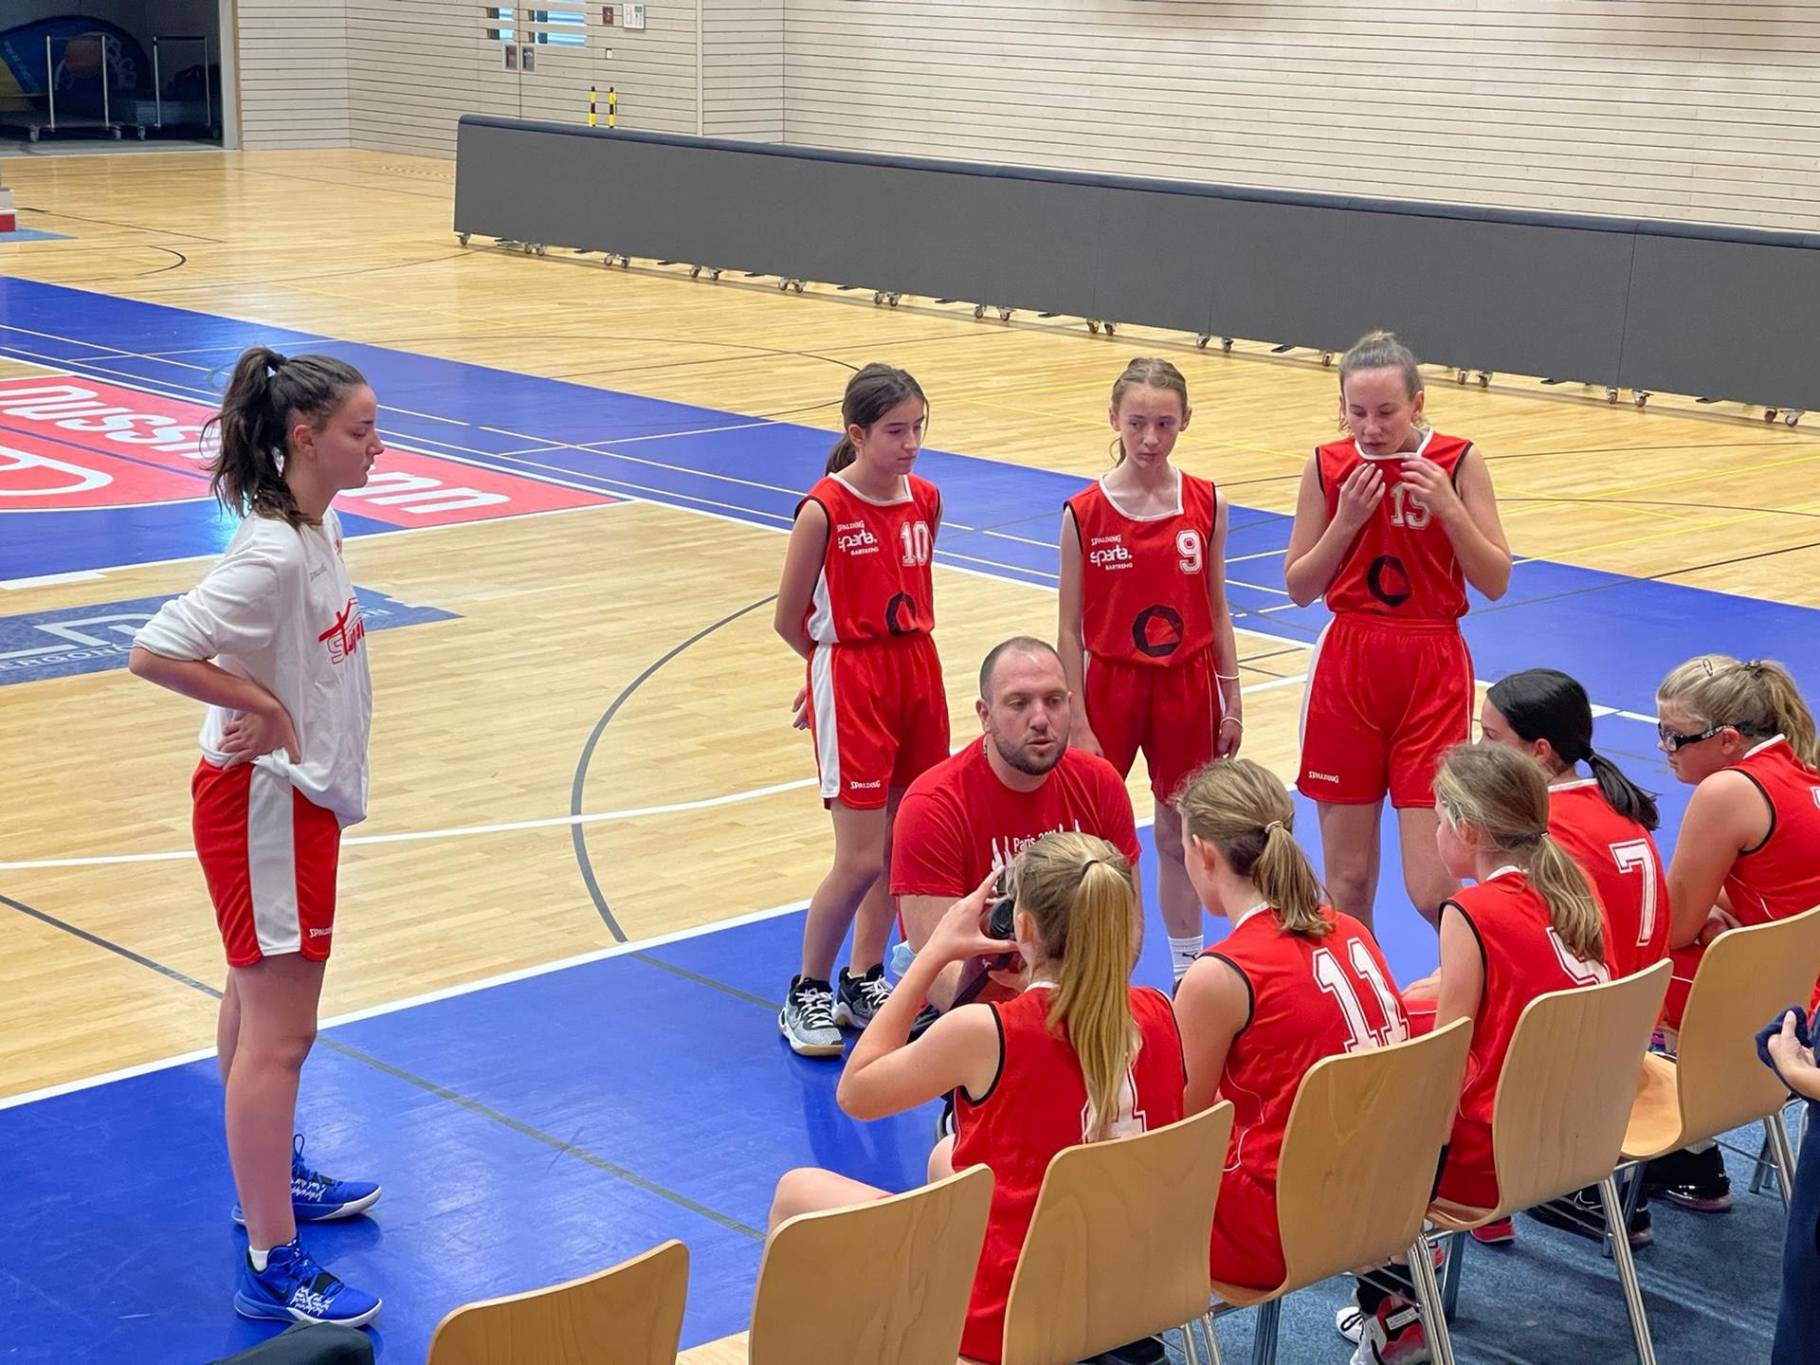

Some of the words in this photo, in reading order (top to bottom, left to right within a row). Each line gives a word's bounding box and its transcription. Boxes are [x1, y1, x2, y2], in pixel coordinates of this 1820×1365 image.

[901, 521, 930, 567] 10
[1176, 529, 1203, 575] 9
[1609, 838, 1657, 947] 7
[1312, 937, 1411, 1054] 11
